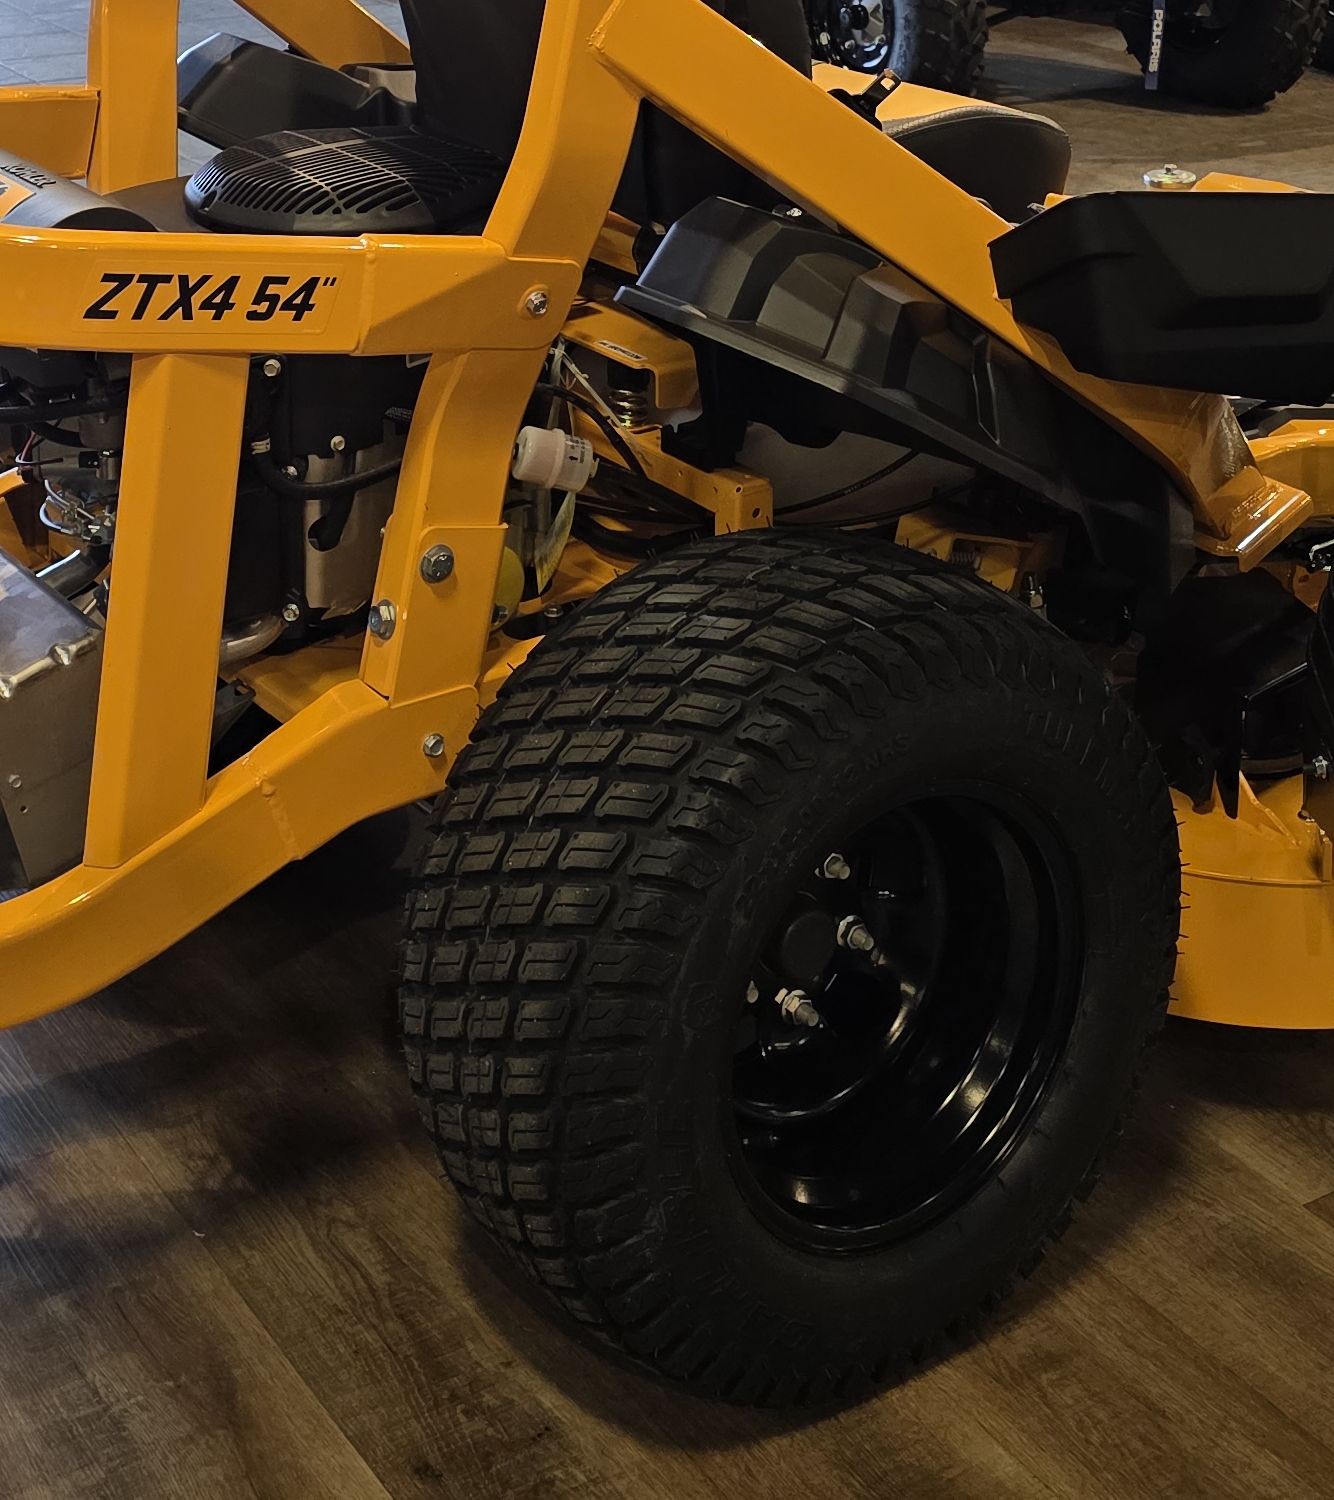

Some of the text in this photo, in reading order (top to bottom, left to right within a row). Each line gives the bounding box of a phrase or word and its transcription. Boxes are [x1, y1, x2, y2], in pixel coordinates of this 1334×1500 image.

[1148, 9, 1164, 73] POLARIS
[82, 272, 338, 322] ZTX4 54"
